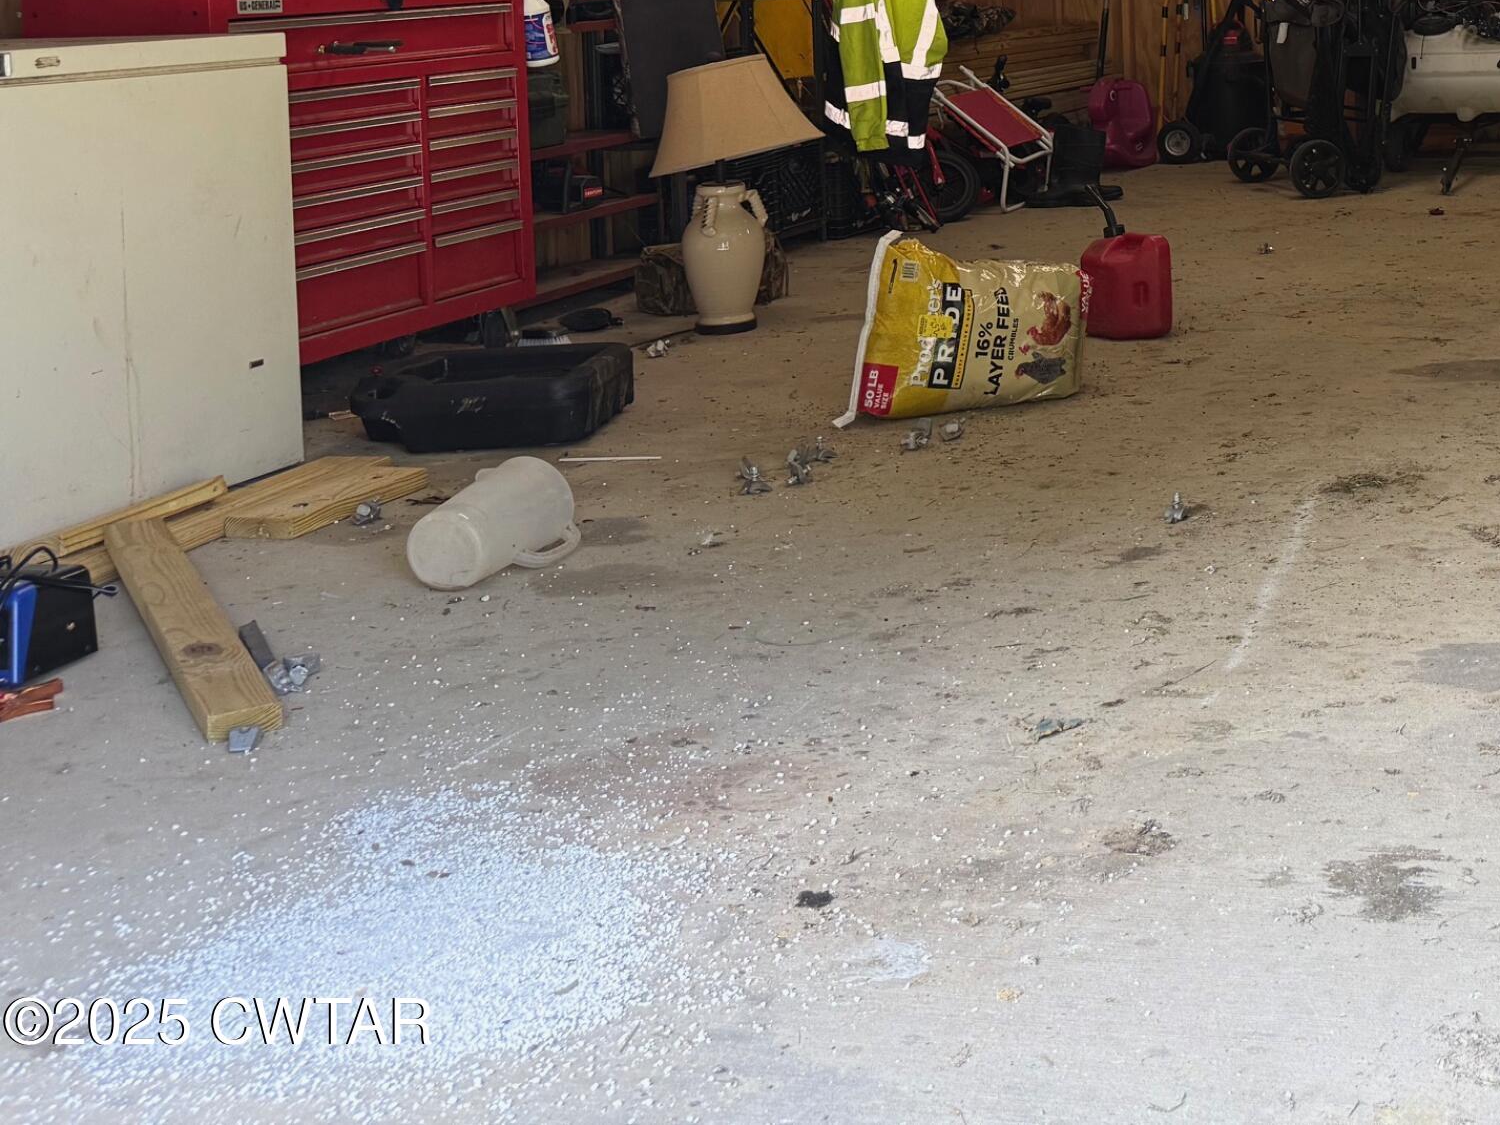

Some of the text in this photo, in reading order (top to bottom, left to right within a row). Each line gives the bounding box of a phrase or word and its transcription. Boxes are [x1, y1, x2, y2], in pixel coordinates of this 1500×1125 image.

[1079, 269, 1092, 313] VALUE
[975, 321, 993, 358] 16%
[984, 286, 1010, 395] LAYER FEED
[1008, 318, 1019, 361] CRUMBLES
[864, 370, 879, 408] 50 LB
[873, 384, 884, 409] VALUE
[880, 392, 889, 410] SIZE
